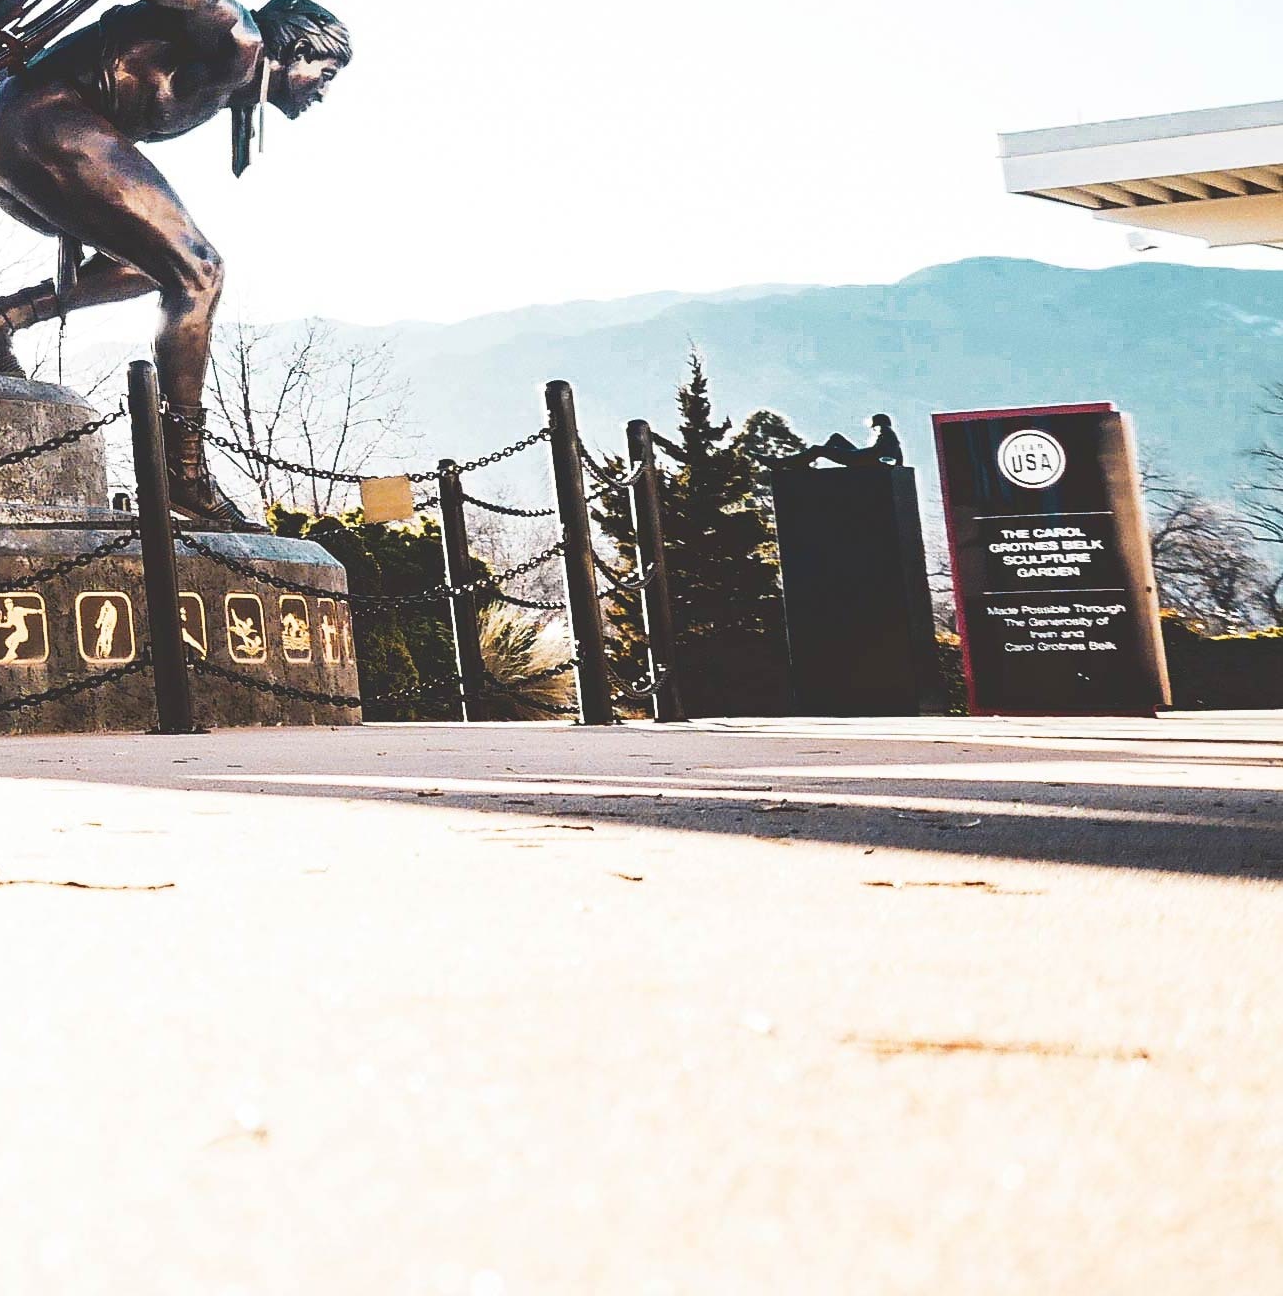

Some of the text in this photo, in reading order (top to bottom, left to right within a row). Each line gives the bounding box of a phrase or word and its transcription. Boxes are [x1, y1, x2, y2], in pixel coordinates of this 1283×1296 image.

[1012, 454, 1052, 473] USA
[1000, 527, 1086, 539] THE CAROL
[989, 540, 1104, 553] GROTNES BELK
[1003, 553, 1091, 565] SCULPTURE
[1017, 567, 1080, 577] GARDEN
[987, 604, 1126, 615] Made Possible Through
[1029, 618, 1093, 627] Generosity
[1096, 617, 1109, 625] of
[1005, 643, 1034, 651] Carol
[1089, 641, 1117, 650] Belk
